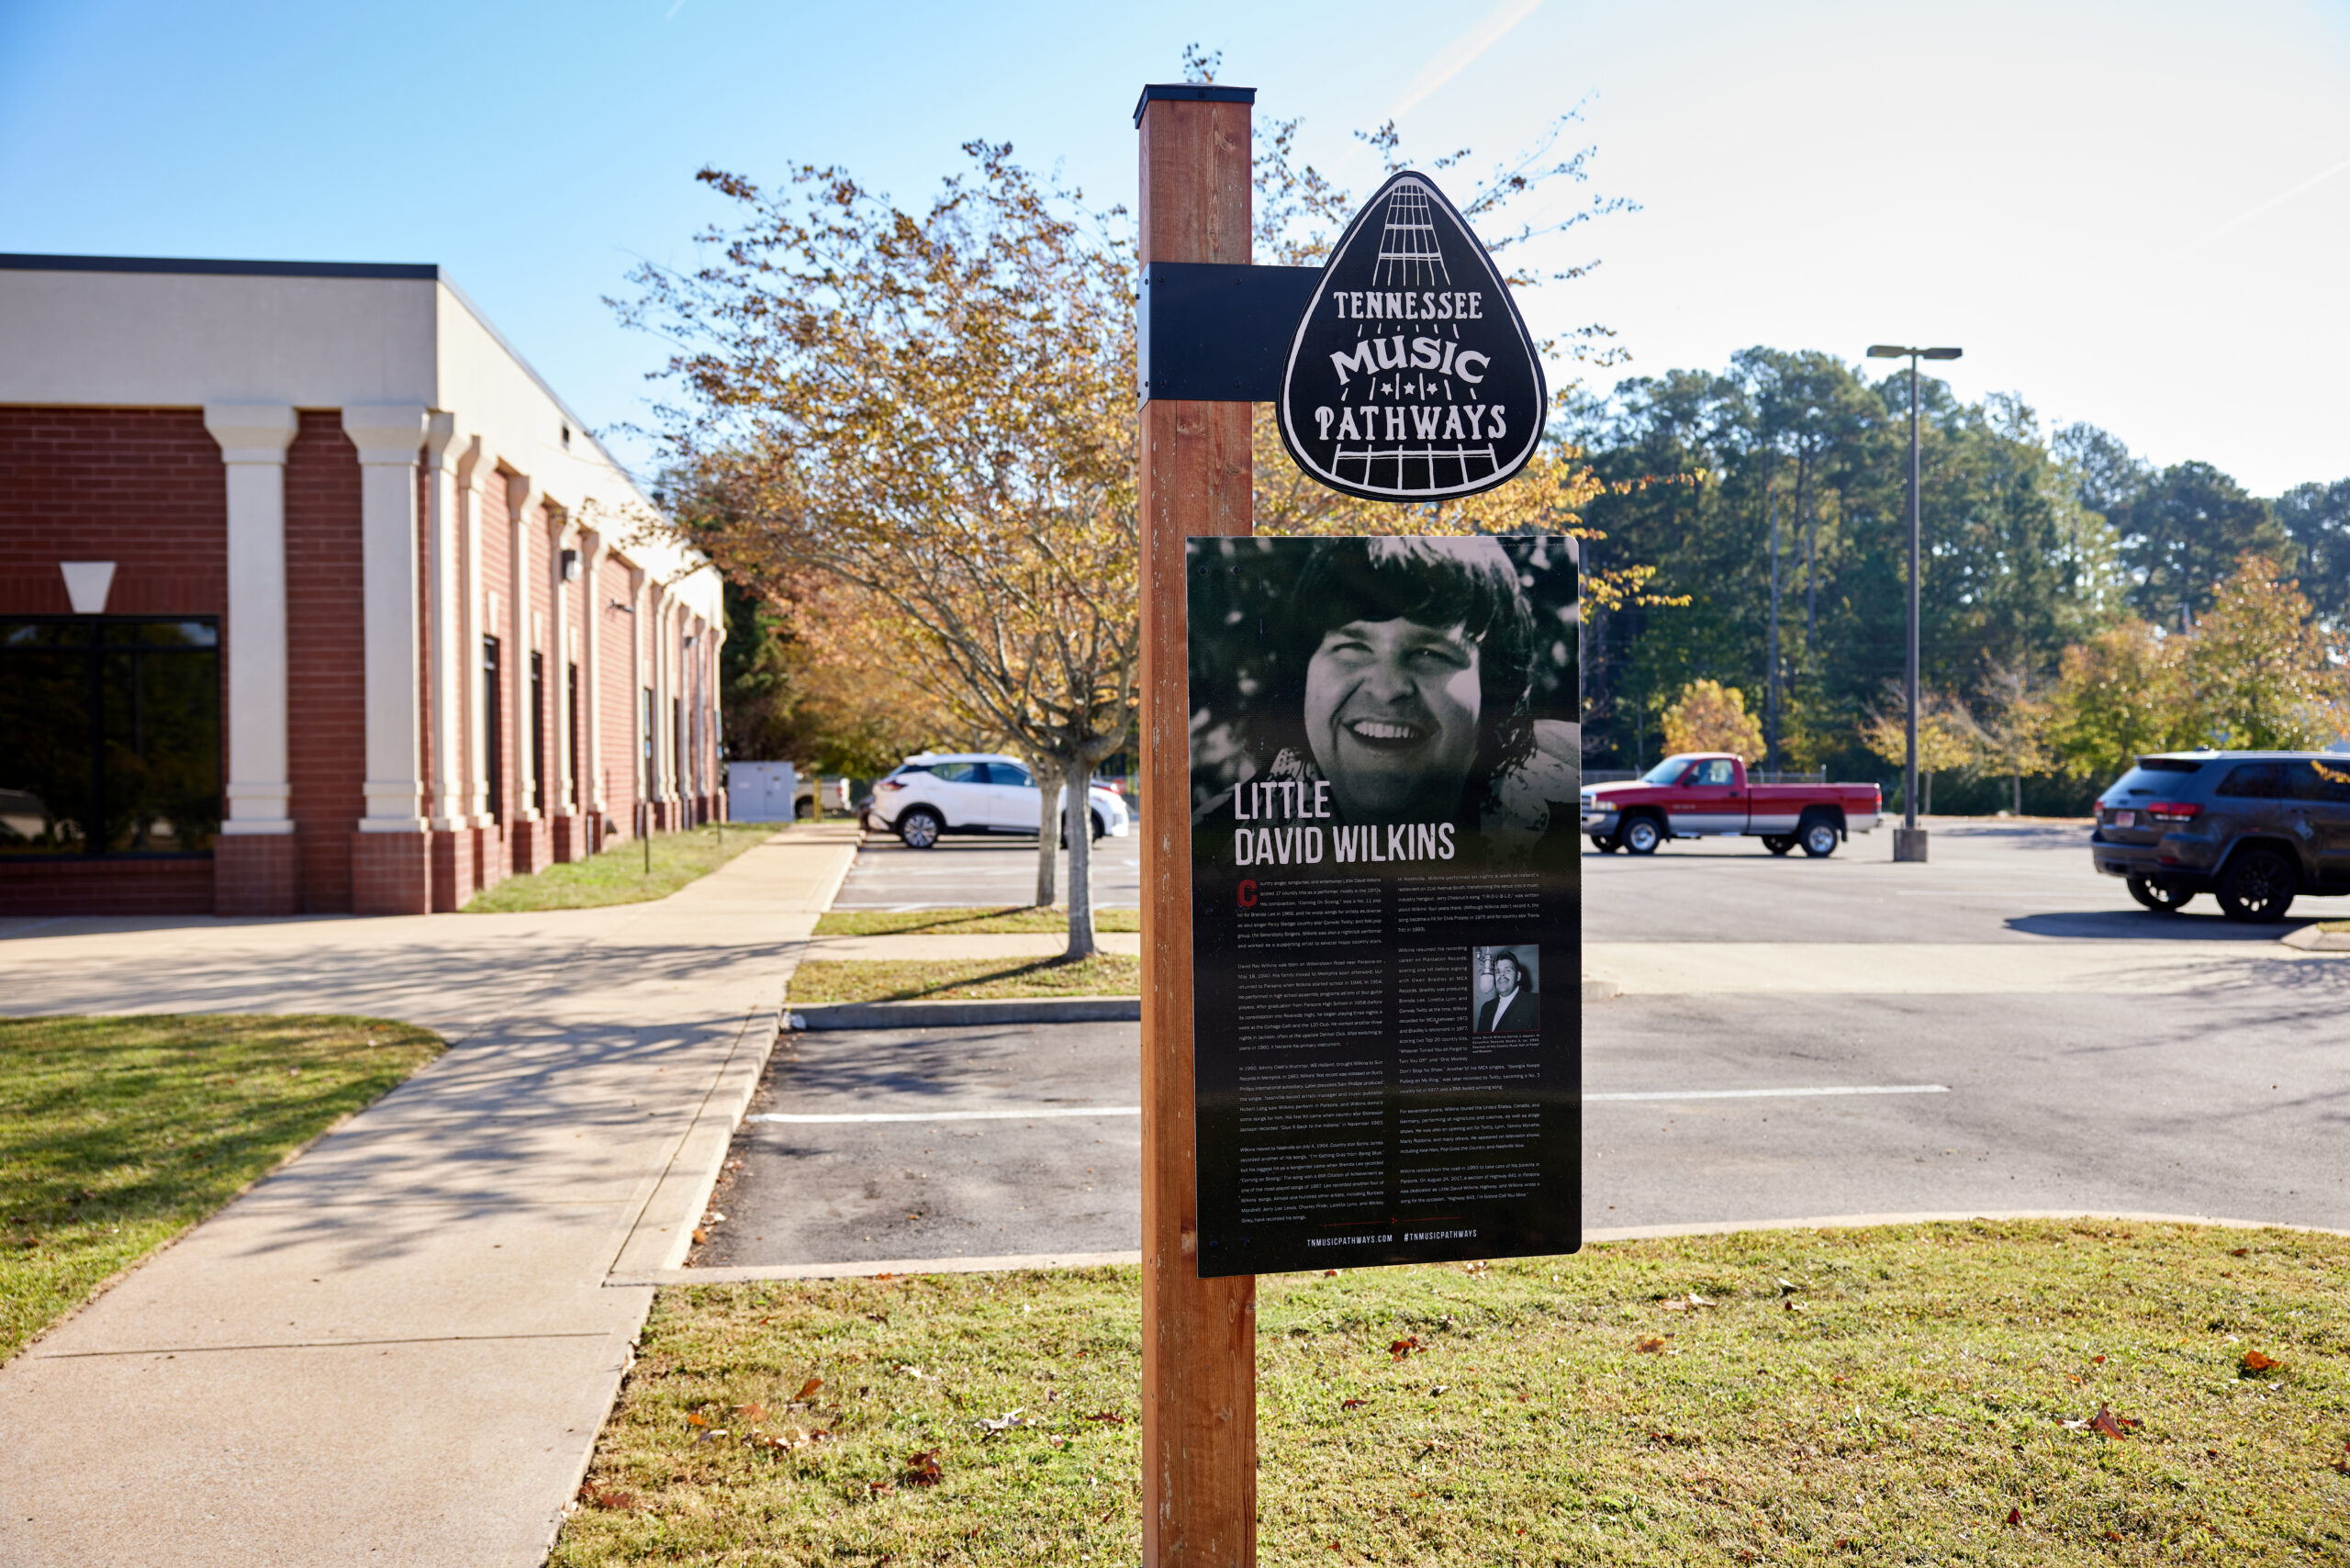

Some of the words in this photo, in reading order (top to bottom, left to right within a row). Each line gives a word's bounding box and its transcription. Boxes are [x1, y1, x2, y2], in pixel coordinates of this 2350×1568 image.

[1333, 291, 1483, 319] TENNESSEE
[1328, 334, 1491, 386] MUSIC
[1315, 404, 1507, 441] PATHWAYS
[1235, 780, 1331, 820] LITTLE
[1235, 826, 1324, 866] DAVID
[1332, 823, 1455, 863] WILKINS
[1306, 1234, 1393, 1248] TNMUSICPATHWAYS.COM
[1404, 1229, 1477, 1242] #TNMUSICPATHWAYS
